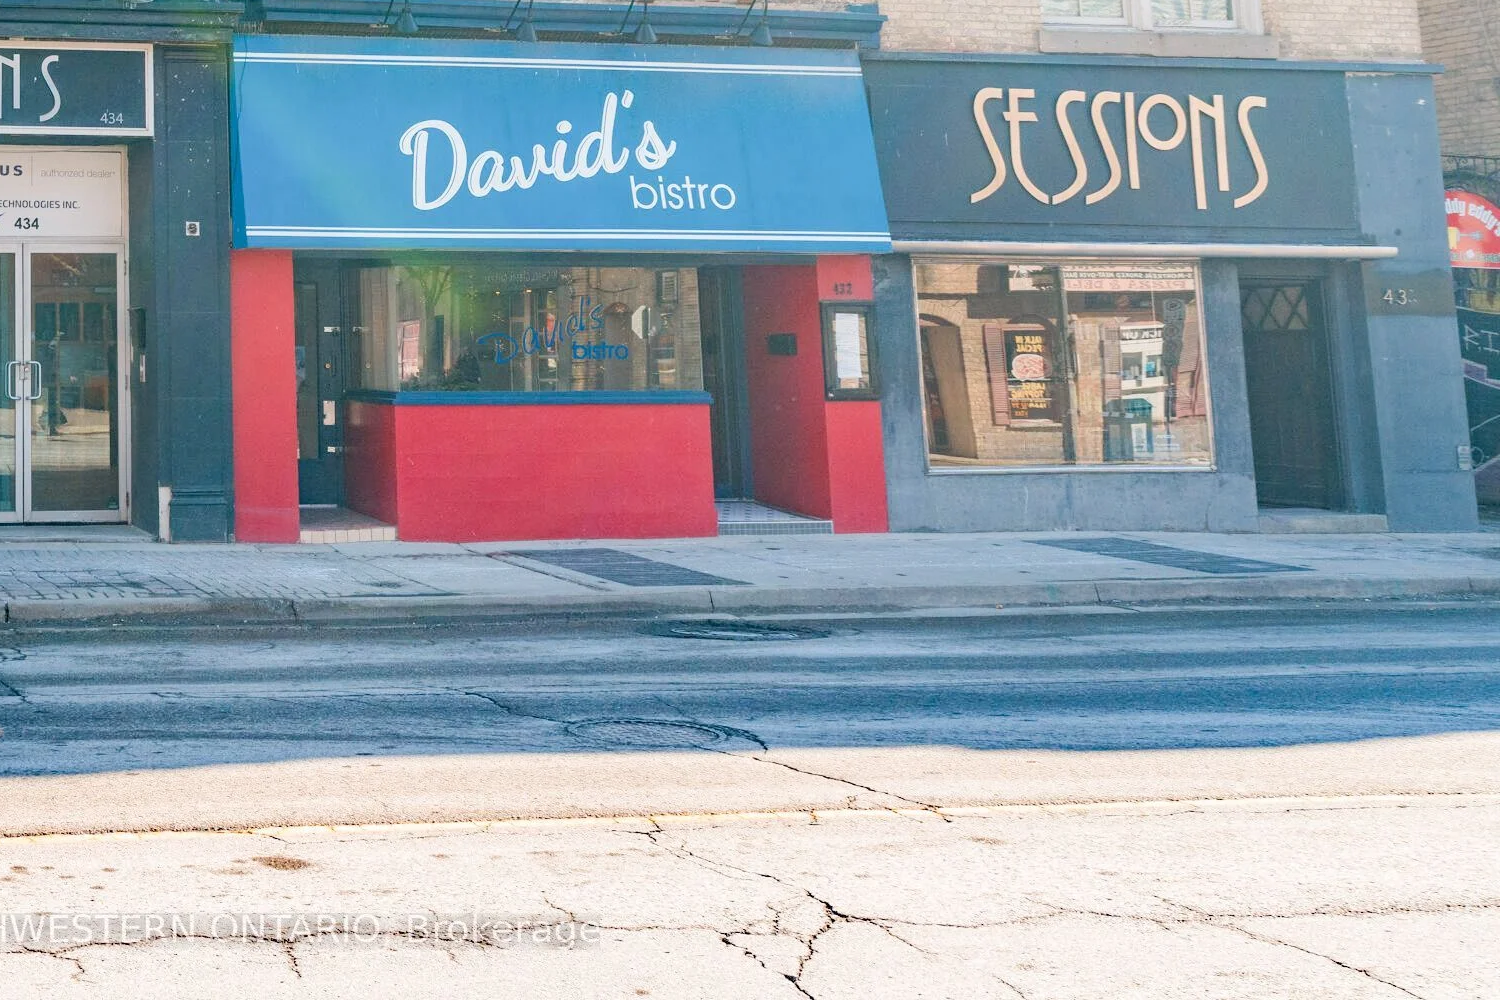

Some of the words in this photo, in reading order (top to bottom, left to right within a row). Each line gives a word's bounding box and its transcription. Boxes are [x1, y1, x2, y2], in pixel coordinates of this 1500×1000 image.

[100, 112, 124, 125] 434
[399, 89, 677, 211] David's
[970, 87, 1269, 210] SESSIONS
[62, 200, 81, 209] INC.
[629, 175, 736, 210] bistro
[14, 217, 40, 230] 434
[477, 295, 605, 364] David's
[571, 340, 629, 360] bistro
